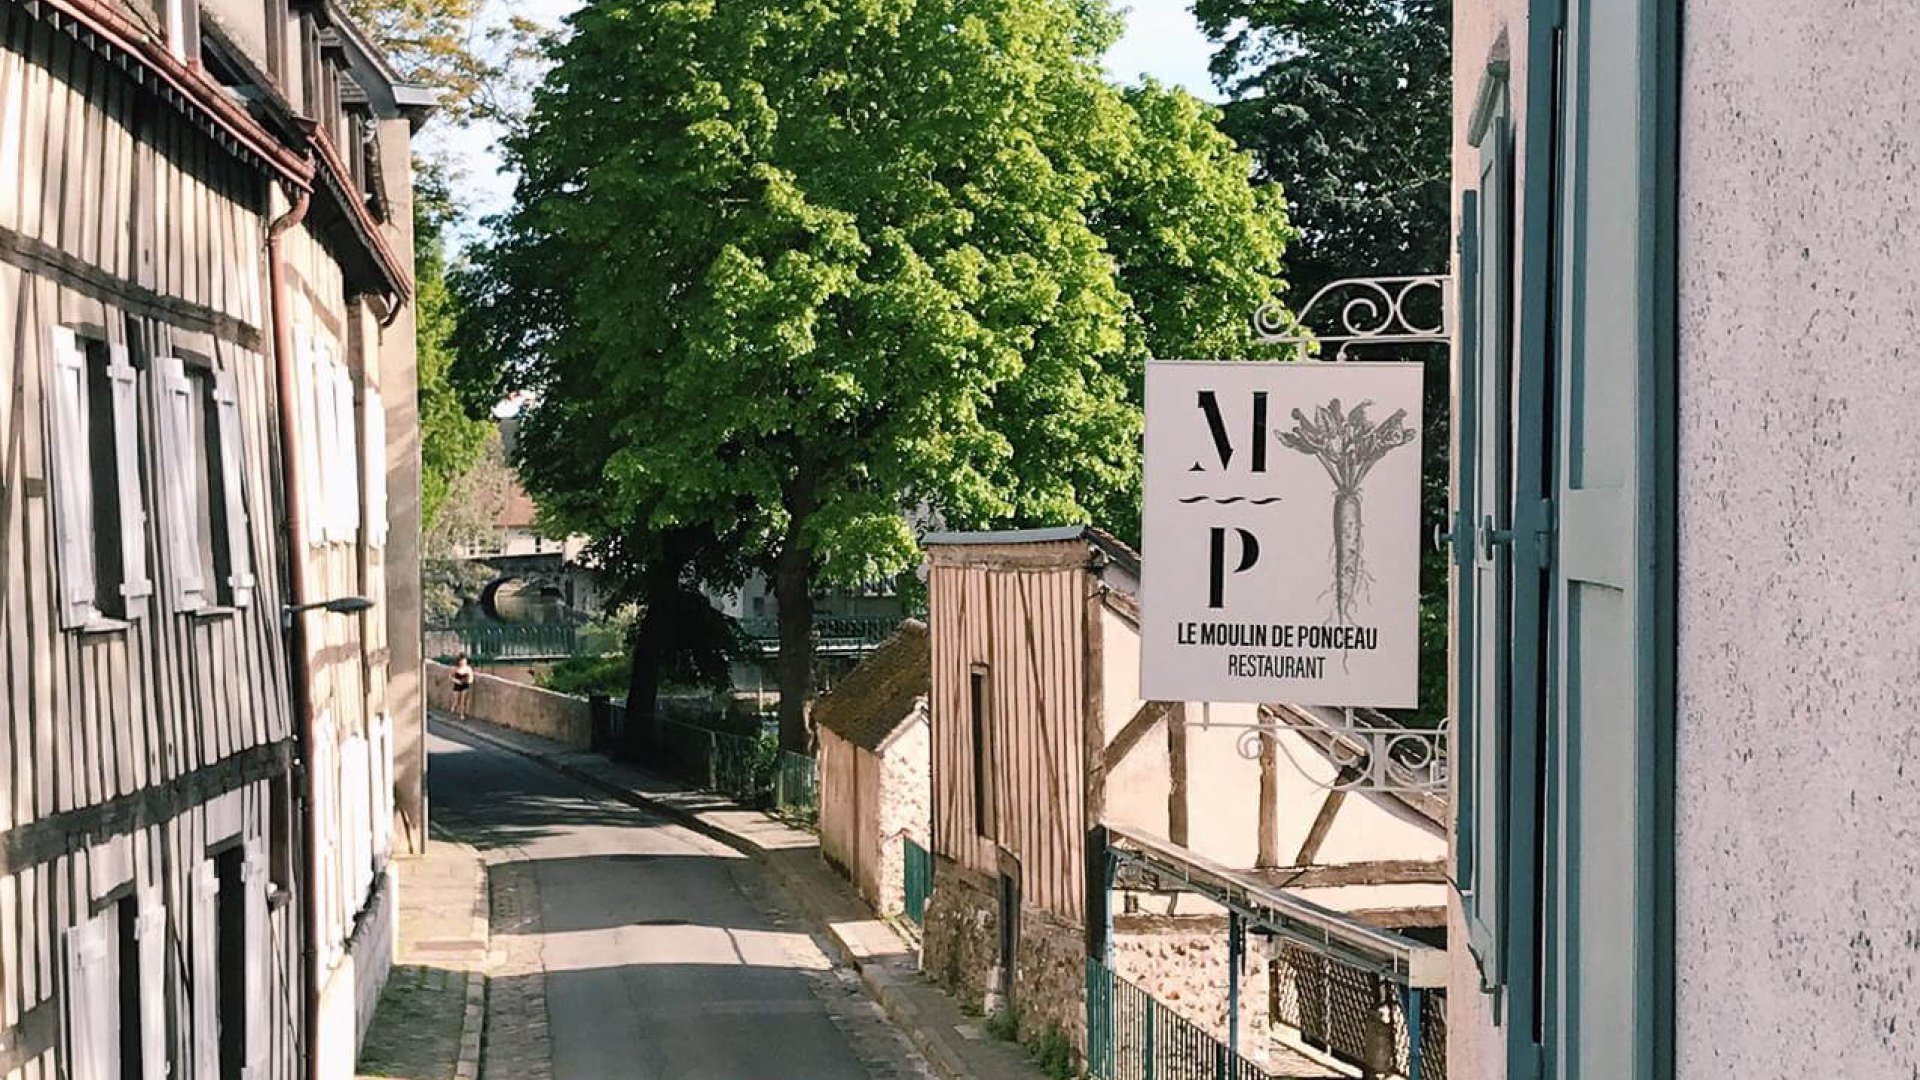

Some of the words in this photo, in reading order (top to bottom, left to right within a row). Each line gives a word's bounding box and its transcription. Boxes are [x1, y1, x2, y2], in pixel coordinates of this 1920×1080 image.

[1188, 391, 1268, 472] M
[1209, 527, 1260, 608] P
[1177, 622, 1197, 645] LE
[1201, 623, 1267, 647] MOULIN
[1272, 625, 1294, 648] DE
[1300, 625, 1377, 650] PONCEAU
[1228, 654, 1326, 679] RESTAURANT
